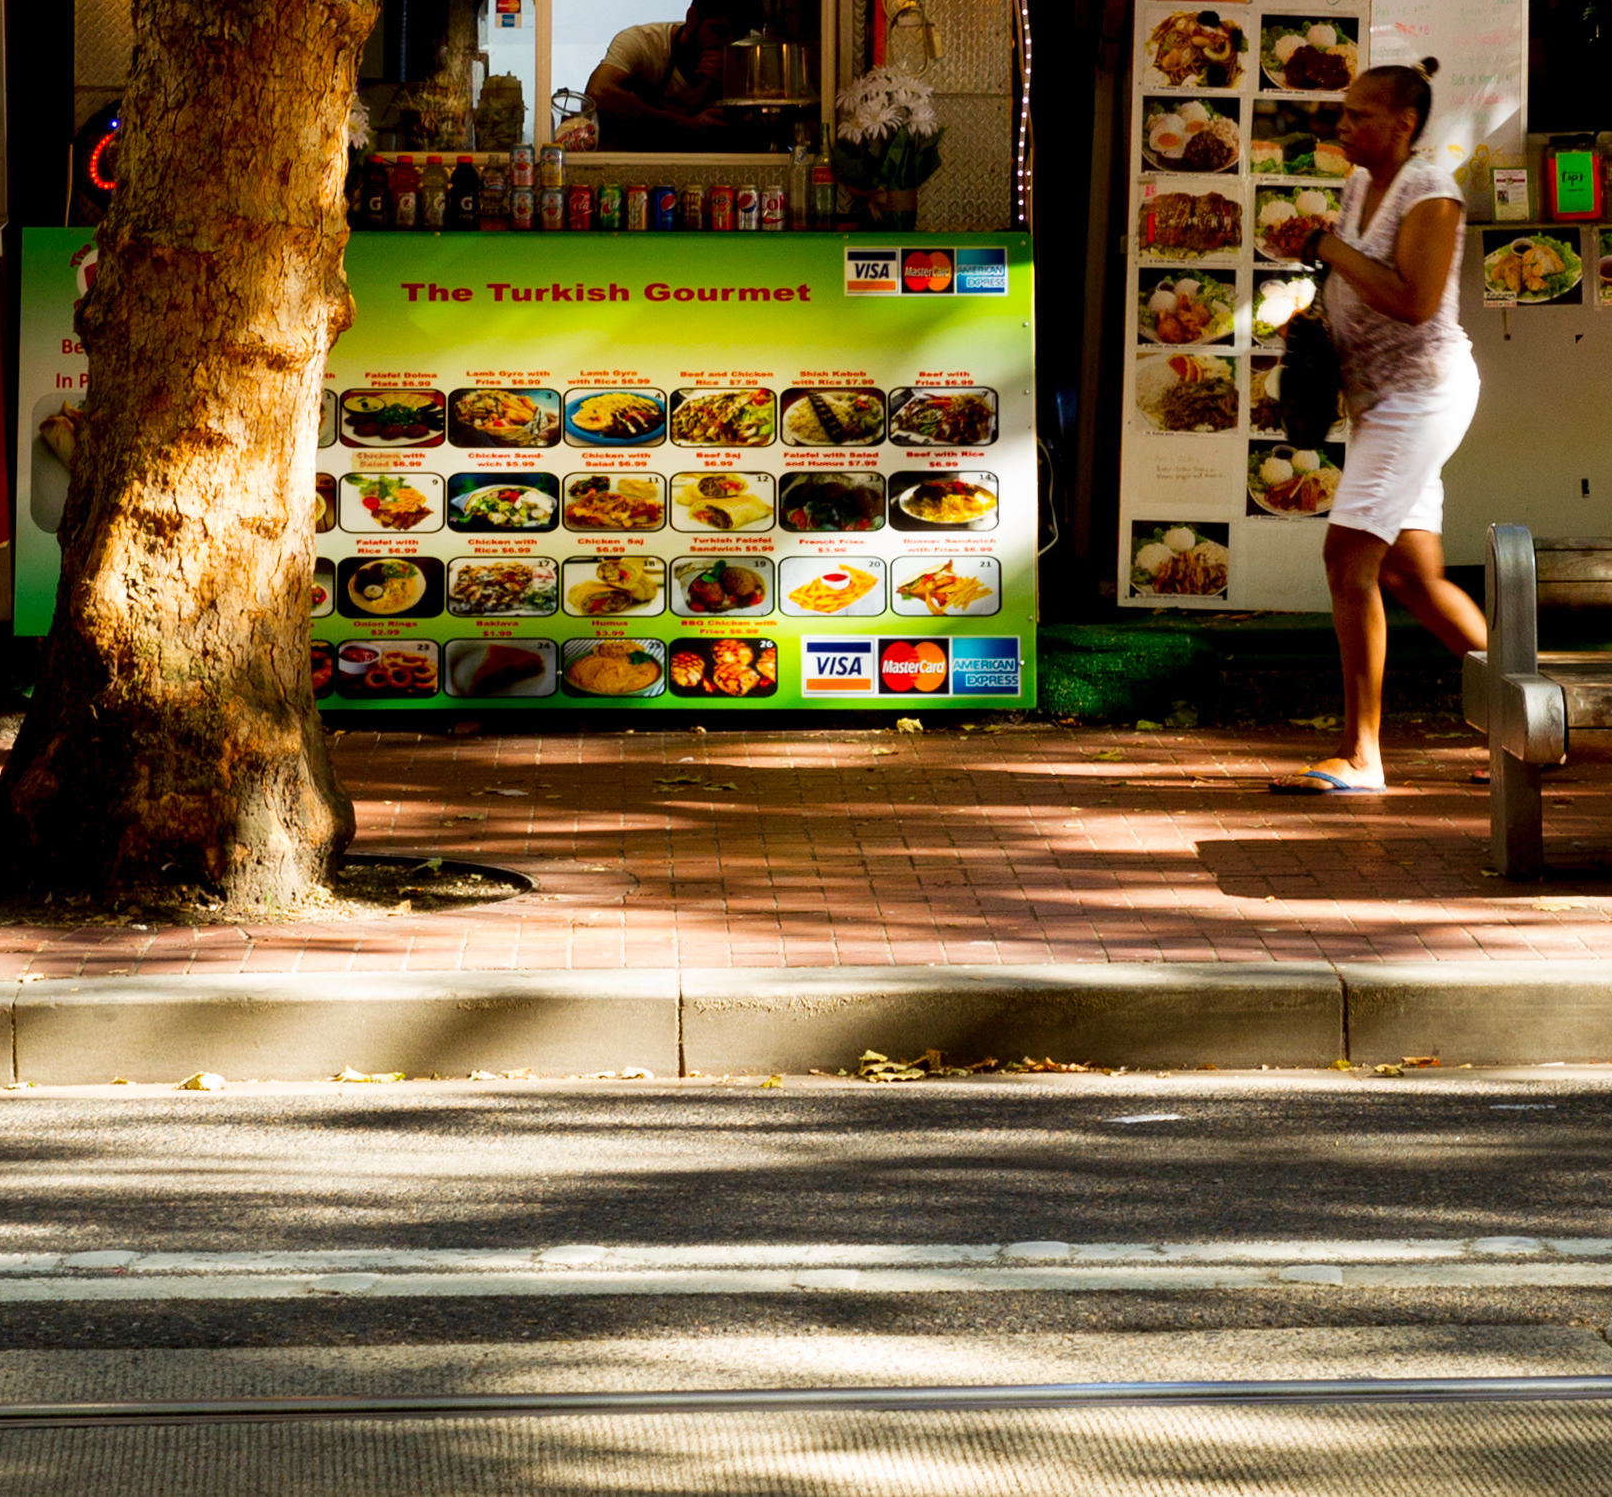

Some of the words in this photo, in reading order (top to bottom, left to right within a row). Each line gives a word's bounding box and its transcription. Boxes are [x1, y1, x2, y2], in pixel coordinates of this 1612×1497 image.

[854, 263, 891, 279] VISA
[904, 266, 951, 277] MasterCard
[957, 265, 1003, 275] AMERICAN
[966, 277, 1006, 287] EXPRESS
[401, 282, 474, 303] The
[488, 281, 637, 303] Turkish
[644, 281, 811, 303] Gourmet
[498, 370, 523, 379] Gyro
[612, 370, 637, 378] Gyro
[387, 621, 417, 629] Rings
[816, 656, 863, 675] VISA
[882, 659, 945, 675] MasterCard
[953, 659, 1015, 670] AMERICAN
[966, 675, 1019, 686] EXPRESS
